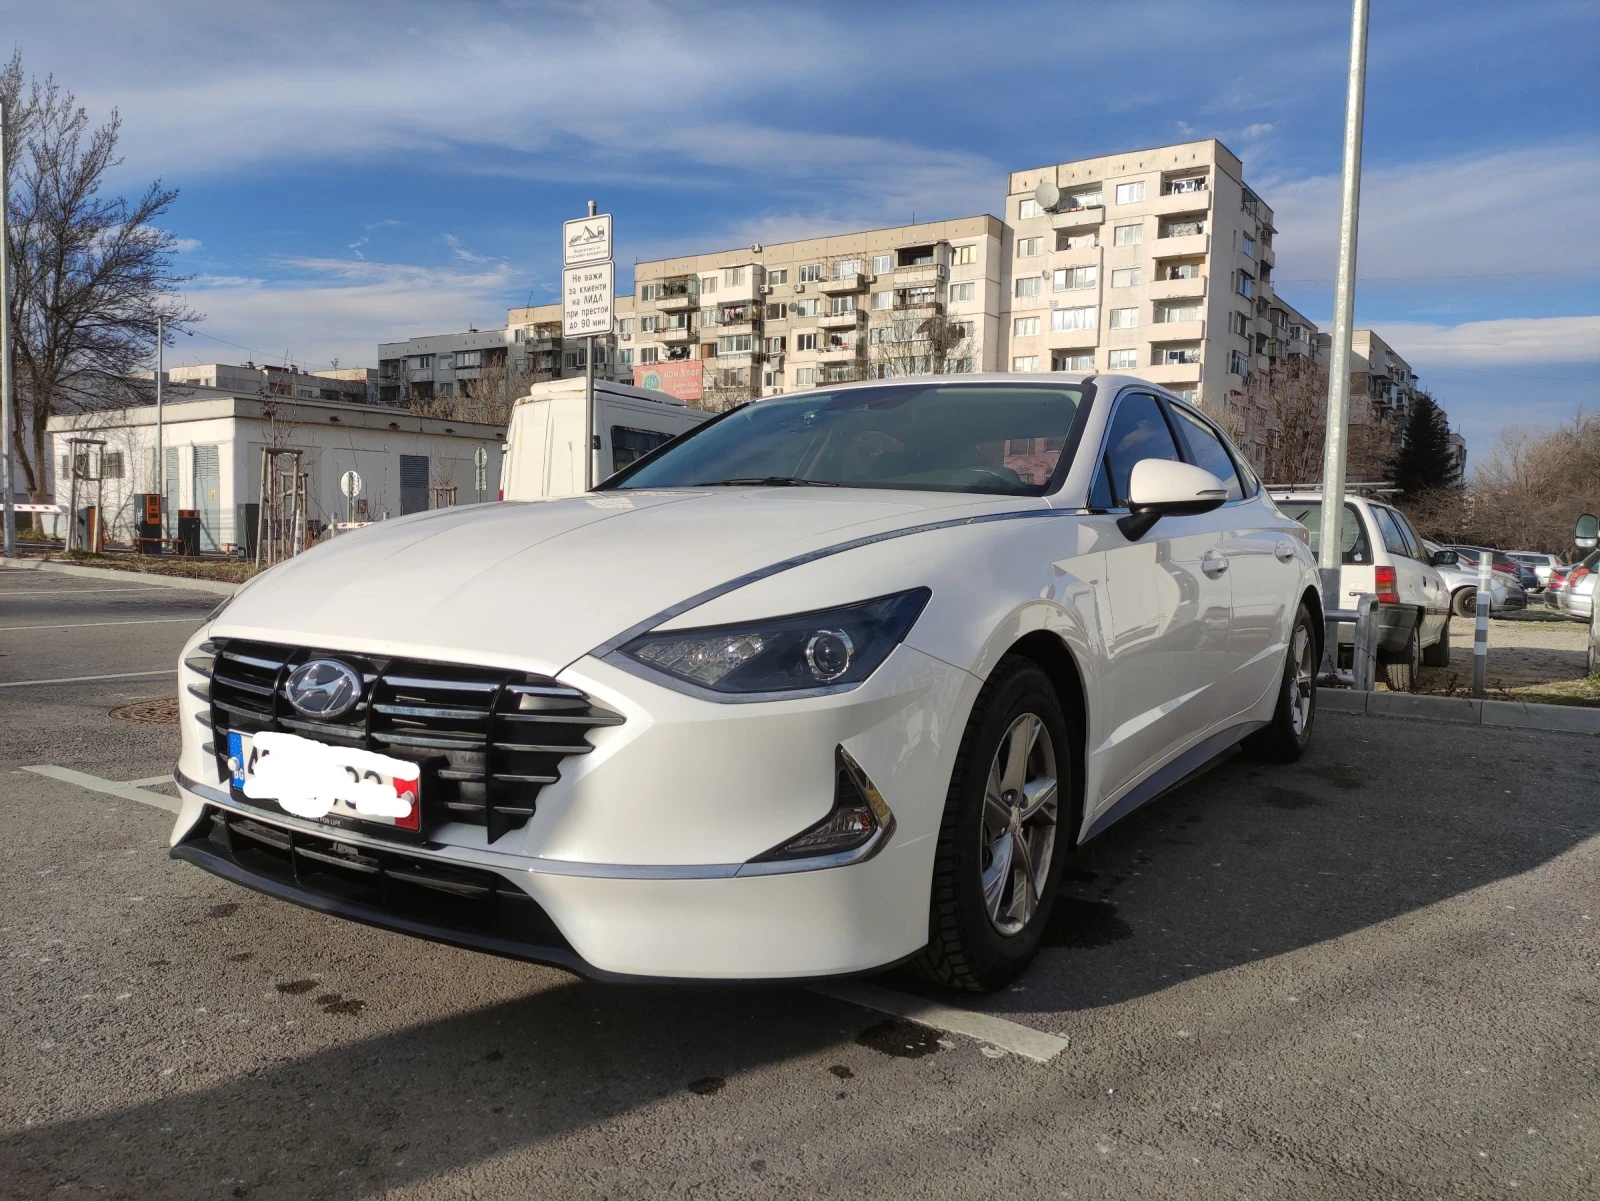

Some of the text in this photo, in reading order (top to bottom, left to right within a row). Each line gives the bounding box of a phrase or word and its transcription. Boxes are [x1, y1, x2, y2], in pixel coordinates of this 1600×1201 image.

[572, 272, 602, 283] Не важи
[568, 284, 606, 295] за клиенти
[571, 293, 602, 306] на ЛИДЛ
[566, 305, 608, 320] при престой
[569, 318, 608, 330] до 90 мин.
[663, 368, 700, 379] NON STOP
[330, 819, 341, 827] LIFE
